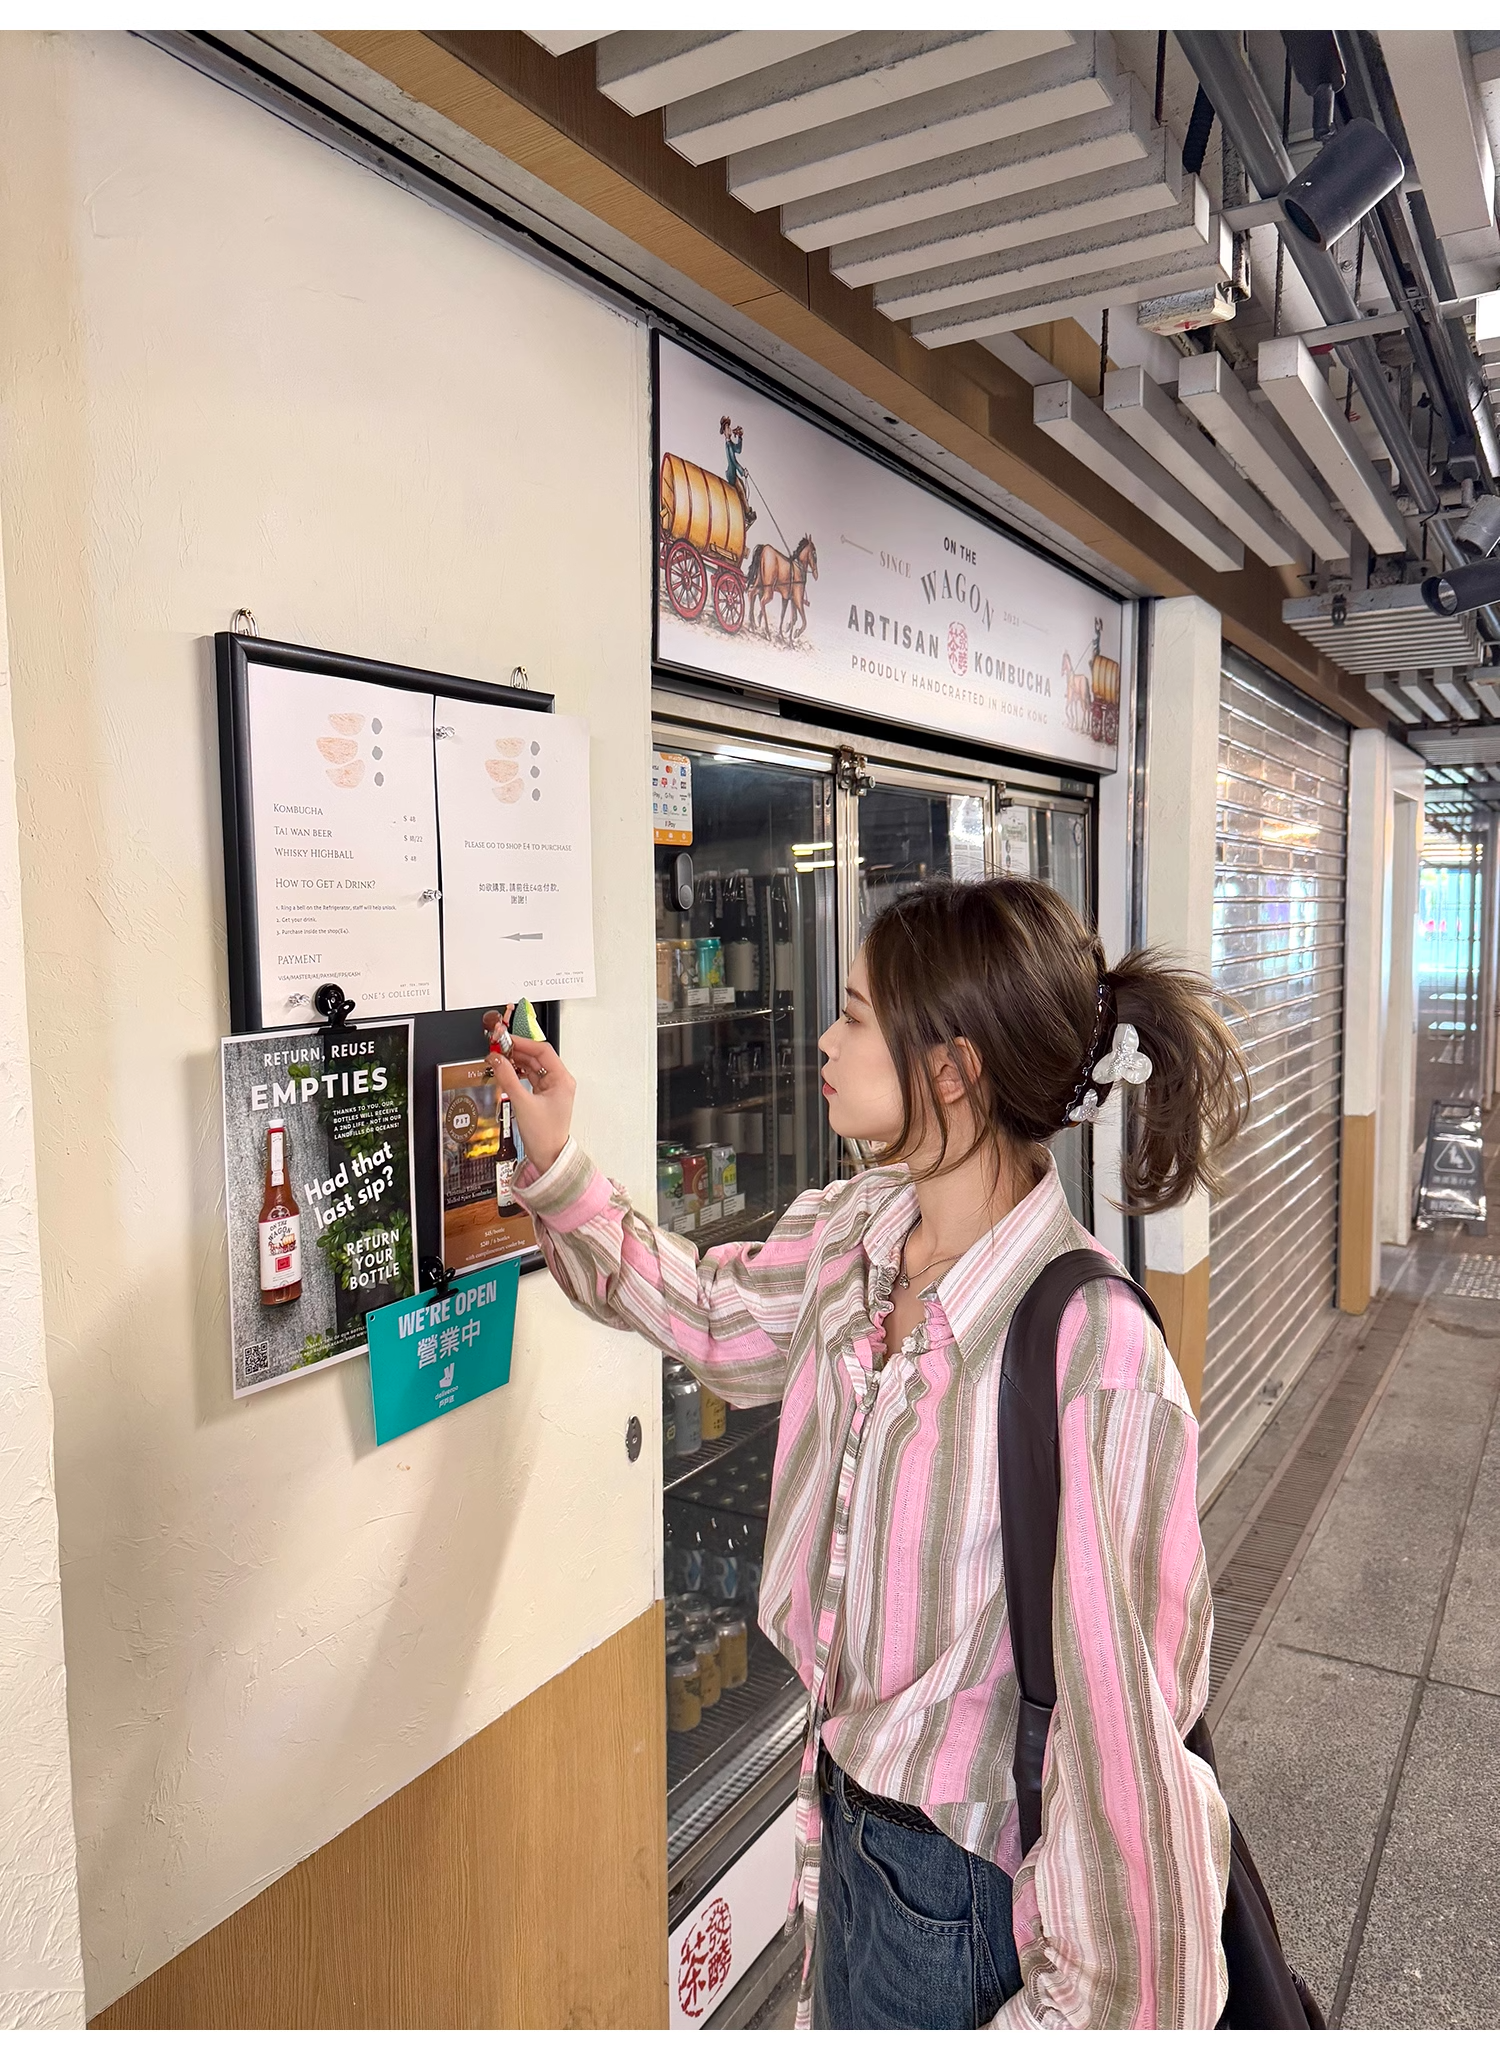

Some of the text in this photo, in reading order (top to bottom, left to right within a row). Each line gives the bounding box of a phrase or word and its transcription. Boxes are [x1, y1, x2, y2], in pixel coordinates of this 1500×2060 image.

[879, 550, 911, 579] SINCE
[943, 536, 977, 566] ON THE
[920, 569, 995, 632] WAGON
[847, 604, 939, 659] ARTISAN
[974, 651, 1052, 698] KOMBUCHA
[851, 655, 1048, 725] PROUDLY HANDCRAFTED IN HONG KONG
[273, 804, 324, 816] KOMBUCHA
[274, 826, 333, 838] TAI WAN BEER
[274, 848, 354, 860] WHISKY HIGHBALL
[278, 954, 322, 965] PAYMENT
[362, 988, 430, 1001] ONE'S COLLECTIVE
[546, 976, 584, 986] COLLECTIVE
[264, 1040, 375, 1067] RETURN, REUSE
[251, 1067, 388, 1112] EMPTIES
[332, 1106, 357, 1116] THANKS
[382, 1100, 394, 1108] OUR
[334, 1114, 359, 1124] BOTTLES
[374, 1107, 398, 1116] RECEIVE
[334, 1129, 365, 1140] LANDFILLS
[374, 1122, 400, 1132] OCEANS!
[304, 1141, 394, 1206] Had that
[314, 1165, 394, 1230] last sip?
[346, 1229, 400, 1257] RETURN
[354, 1247, 394, 1272] YOUR
[350, 1262, 400, 1291] BOTTLE
[398, 1280, 497, 1340] WE'RE OPEN
[417, 1318, 481, 1370] 營業中
